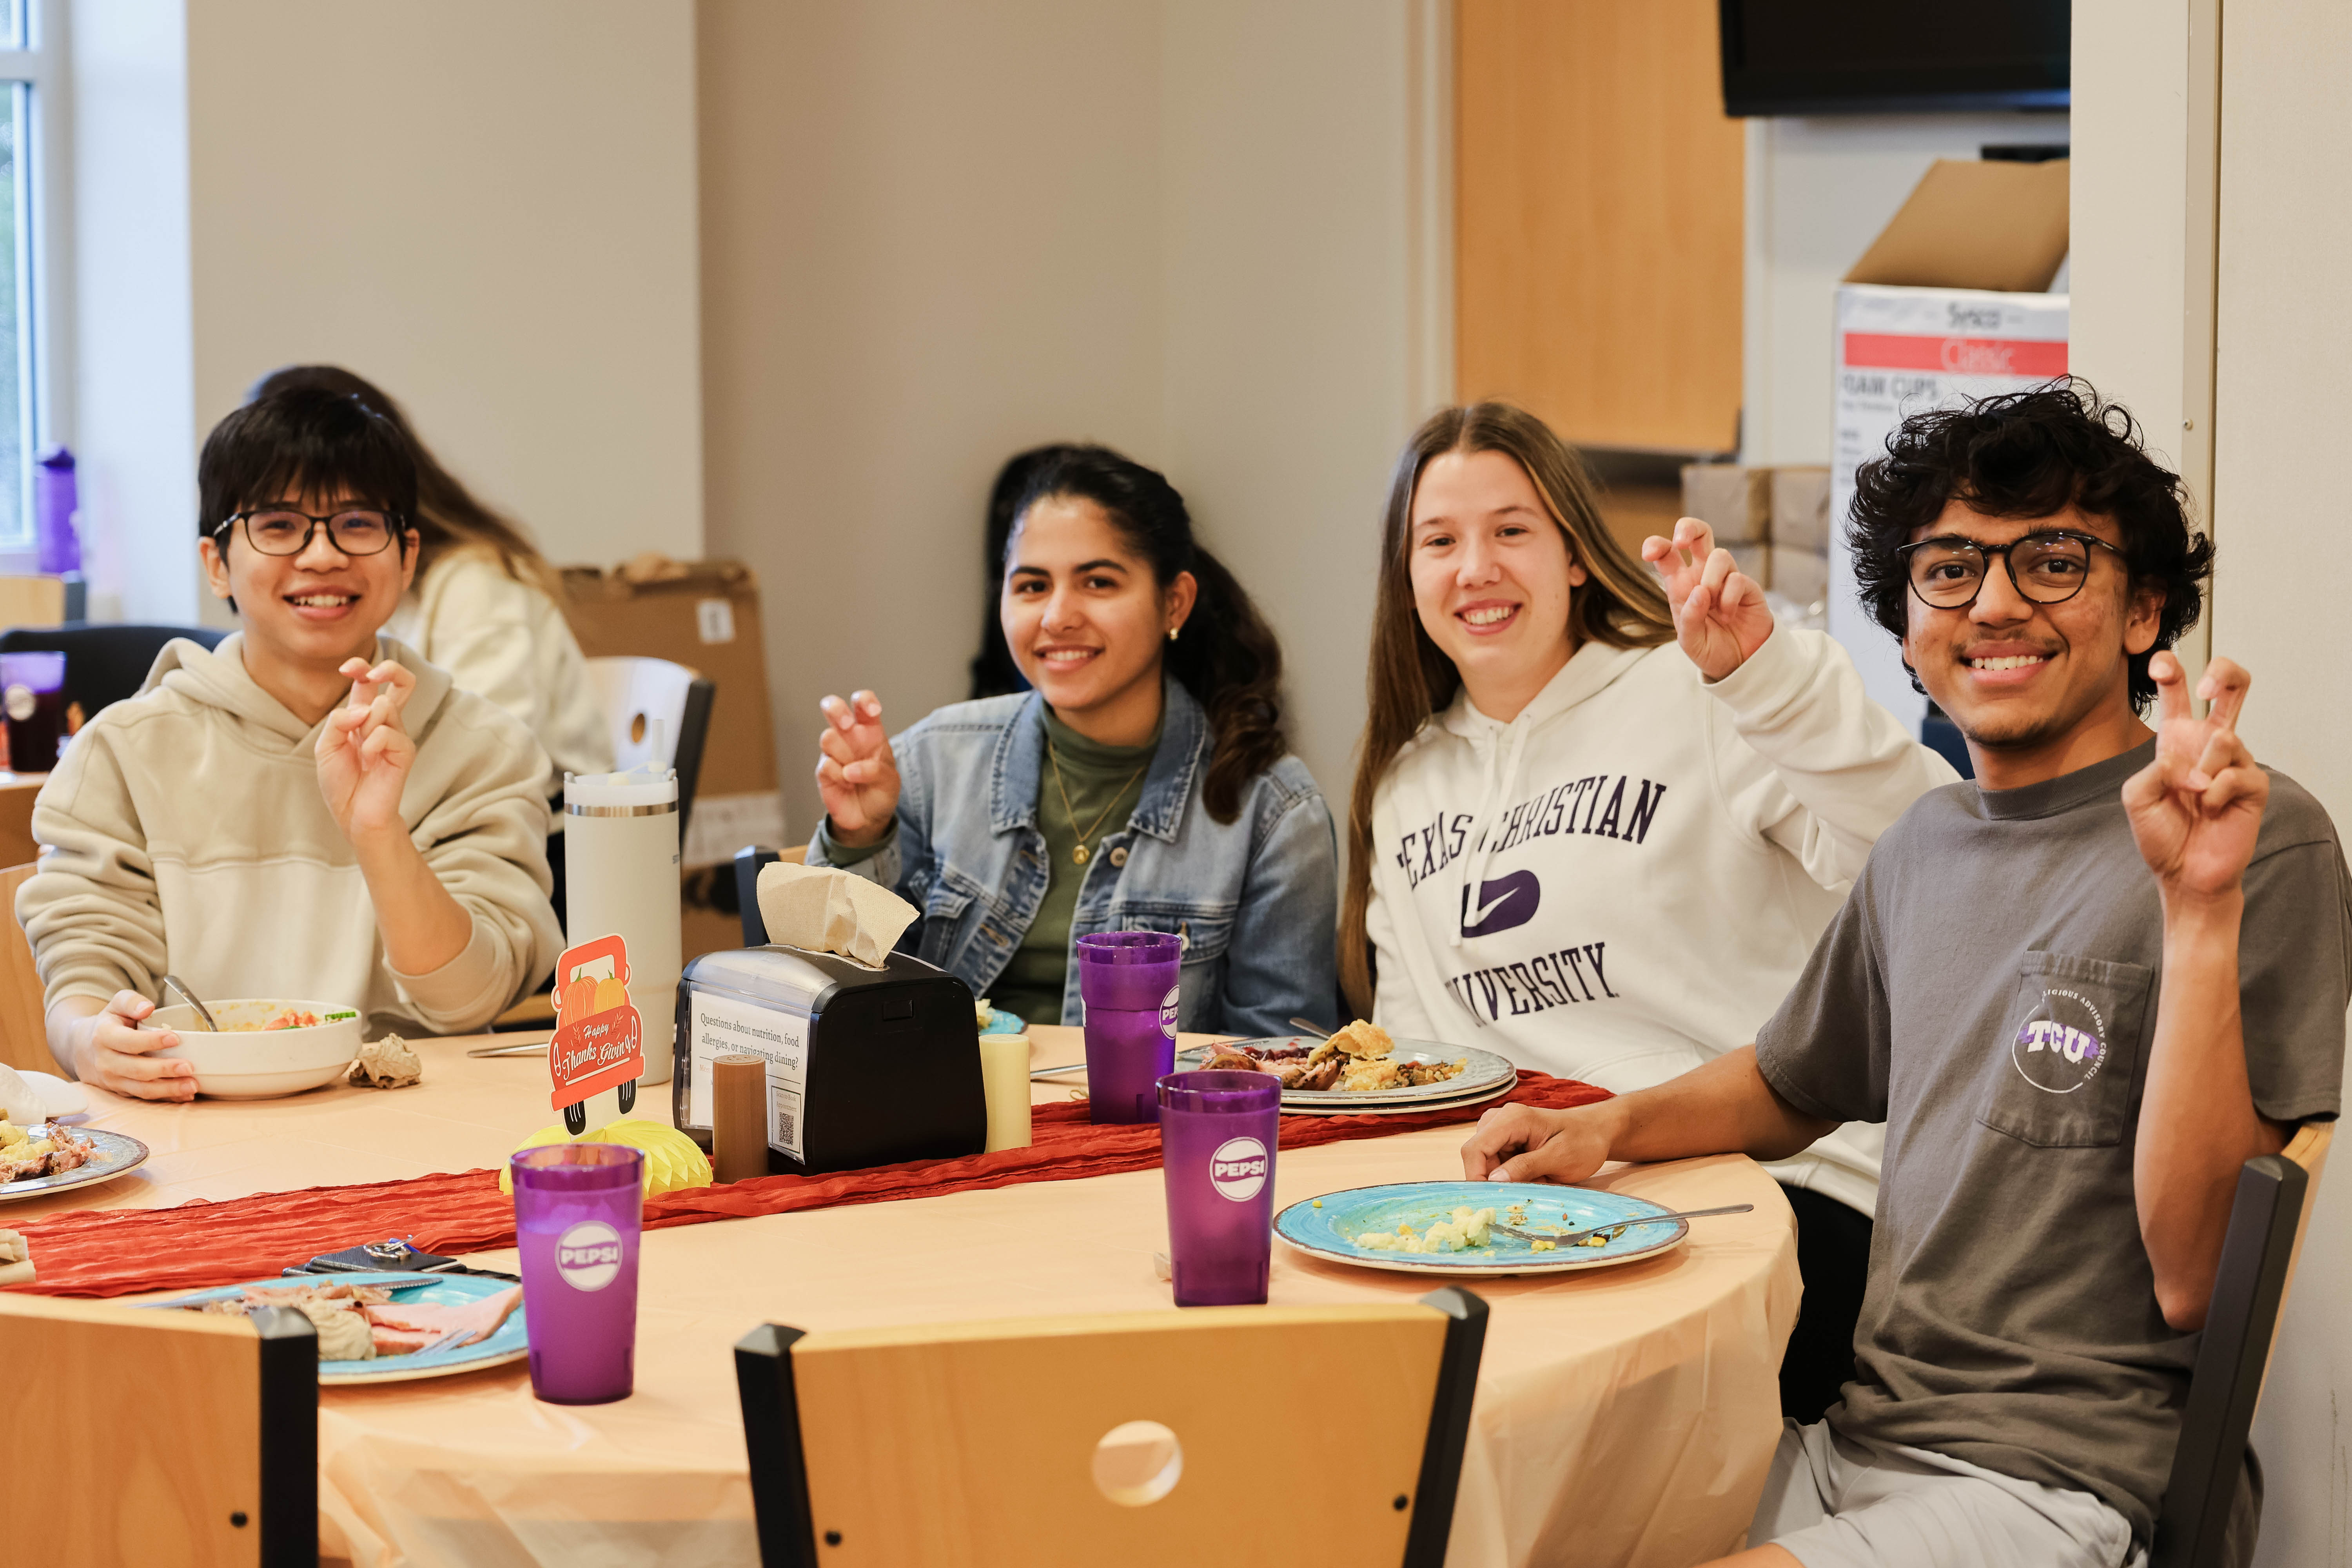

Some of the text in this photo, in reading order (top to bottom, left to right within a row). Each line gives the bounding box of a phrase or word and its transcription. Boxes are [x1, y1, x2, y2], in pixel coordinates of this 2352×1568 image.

[1397, 810, 1474, 891] EXAS
[583, 1023, 609, 1040] Happy
[701, 1013, 799, 1047] Questions about nutrition, food
[1162, 1006, 1178, 1021] PEP
[2079, 996, 2105, 1038] ADVISORY
[562, 1034, 632, 1081] Thanks Giving
[702, 1033, 799, 1070] allergies, or navigating dining?
[2027, 1020, 2091, 1063] TCU
[2083, 1042, 2107, 1080] COUNCIL
[1215, 1159, 1265, 1177] PEPSI
[561, 1246, 618, 1265] PEPSI
